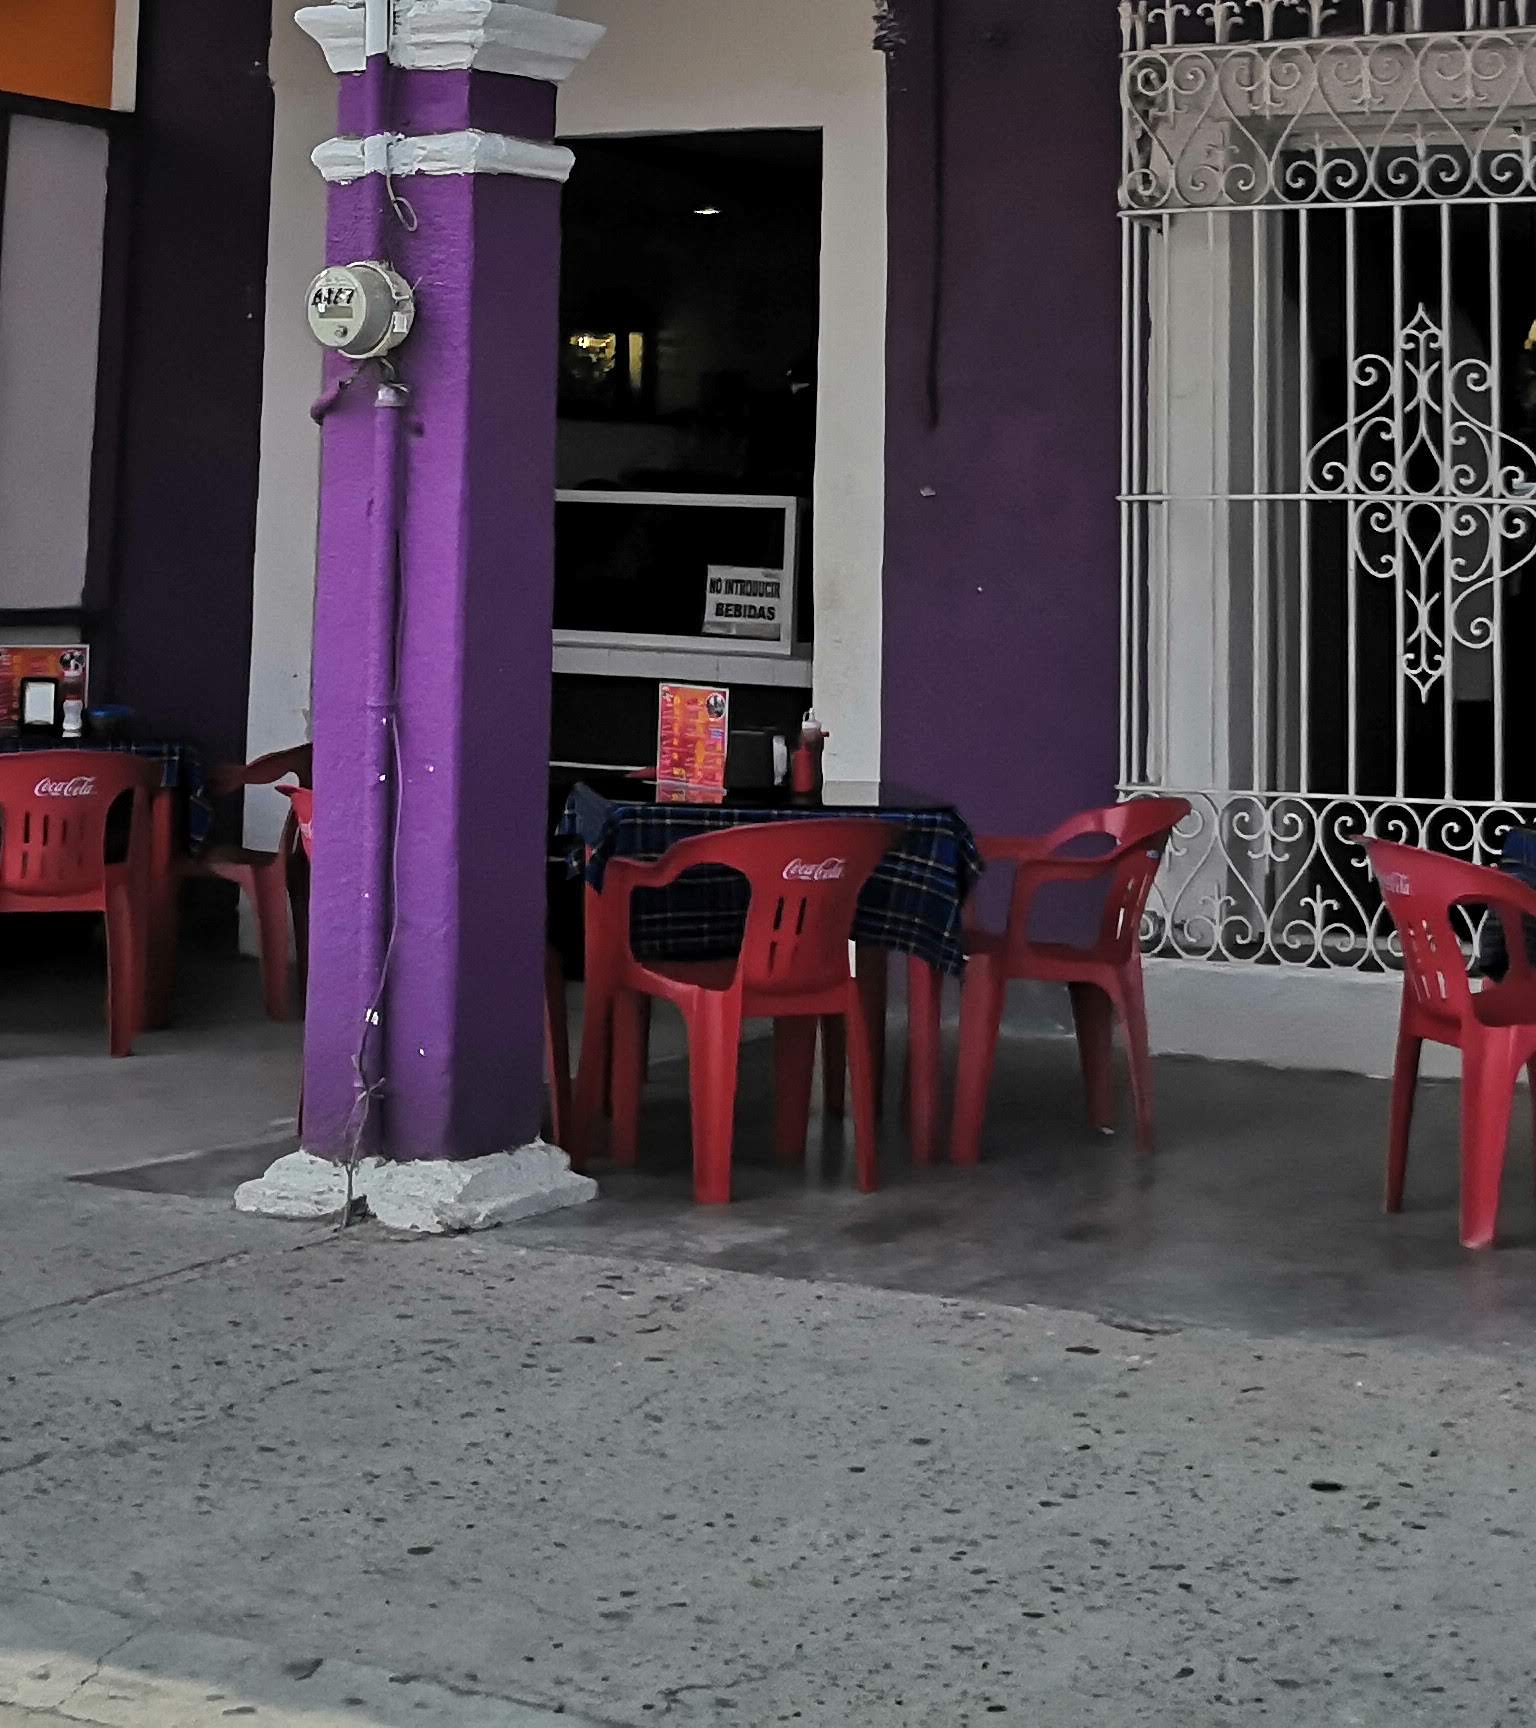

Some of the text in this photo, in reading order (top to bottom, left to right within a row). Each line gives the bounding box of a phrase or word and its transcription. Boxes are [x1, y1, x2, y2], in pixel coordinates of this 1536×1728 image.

[709, 577, 781, 599] NO INTRODUCIR
[715, 601, 777, 621] BEBIDAS
